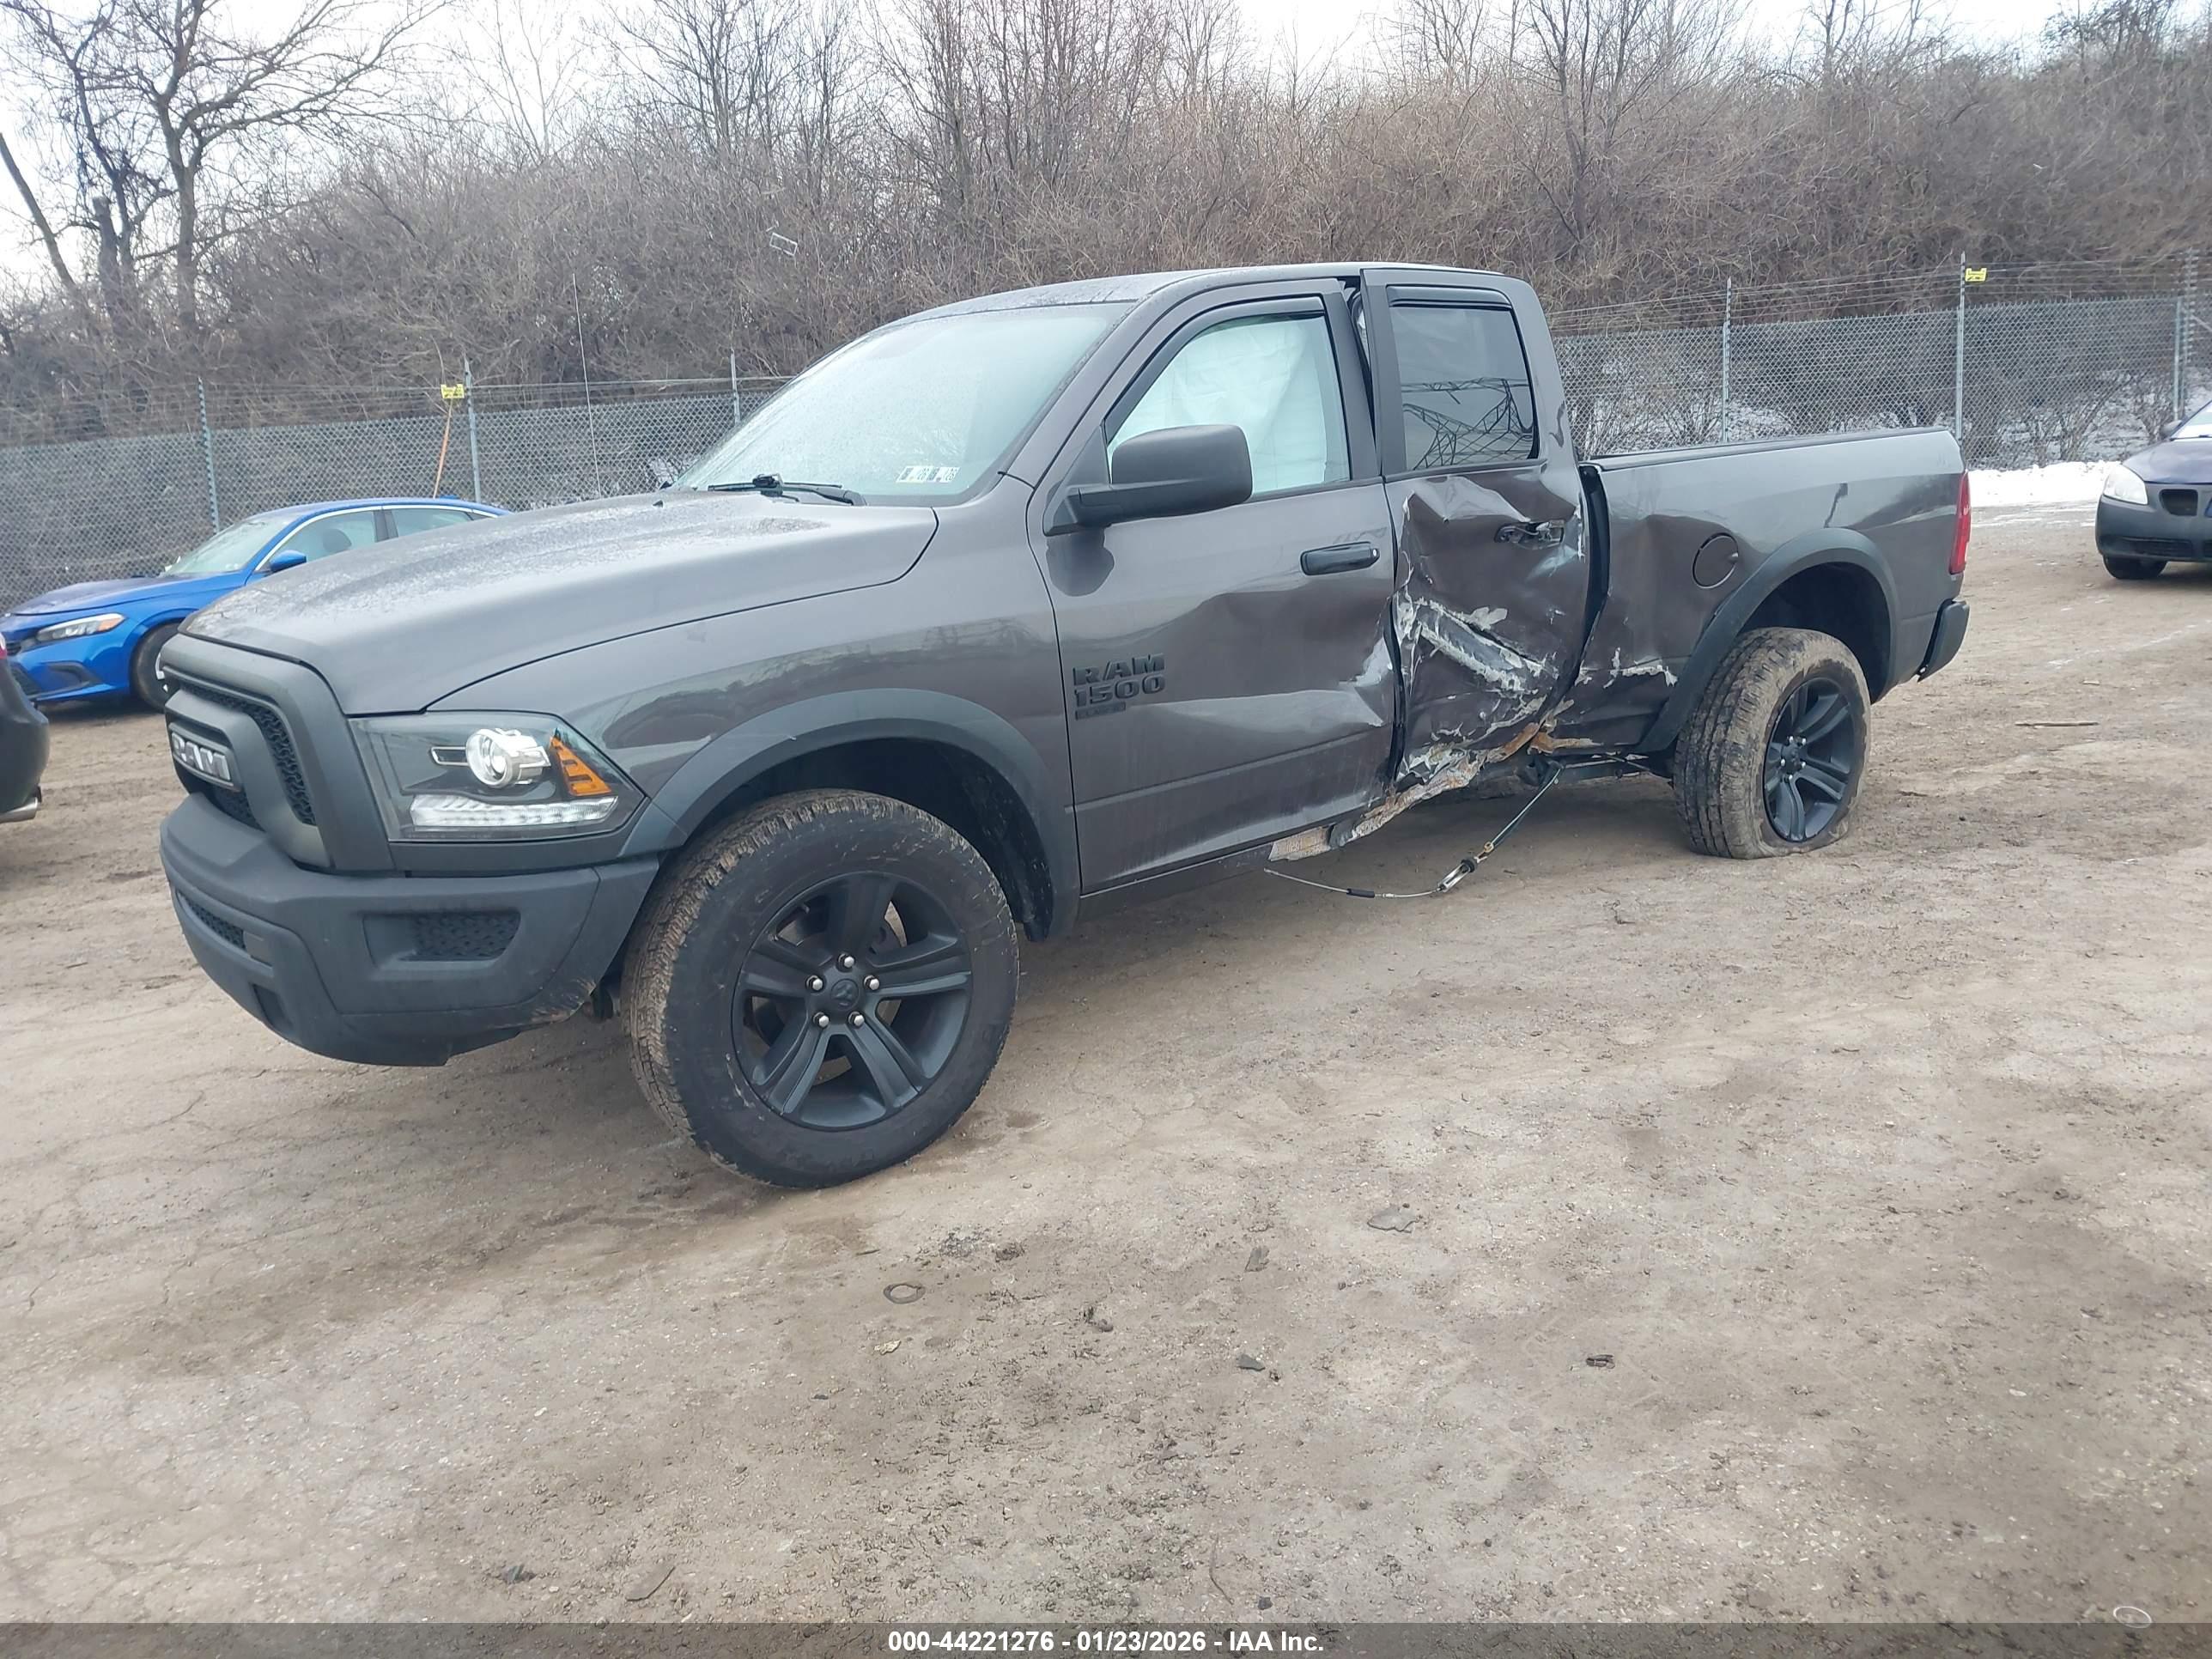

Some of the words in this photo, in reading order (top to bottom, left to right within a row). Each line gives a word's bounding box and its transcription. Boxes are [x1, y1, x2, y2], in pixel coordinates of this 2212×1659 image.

[1073, 653, 1165, 686] RAM
[1074, 674, 1166, 708] 1500
[171, 732, 231, 781] RAM
